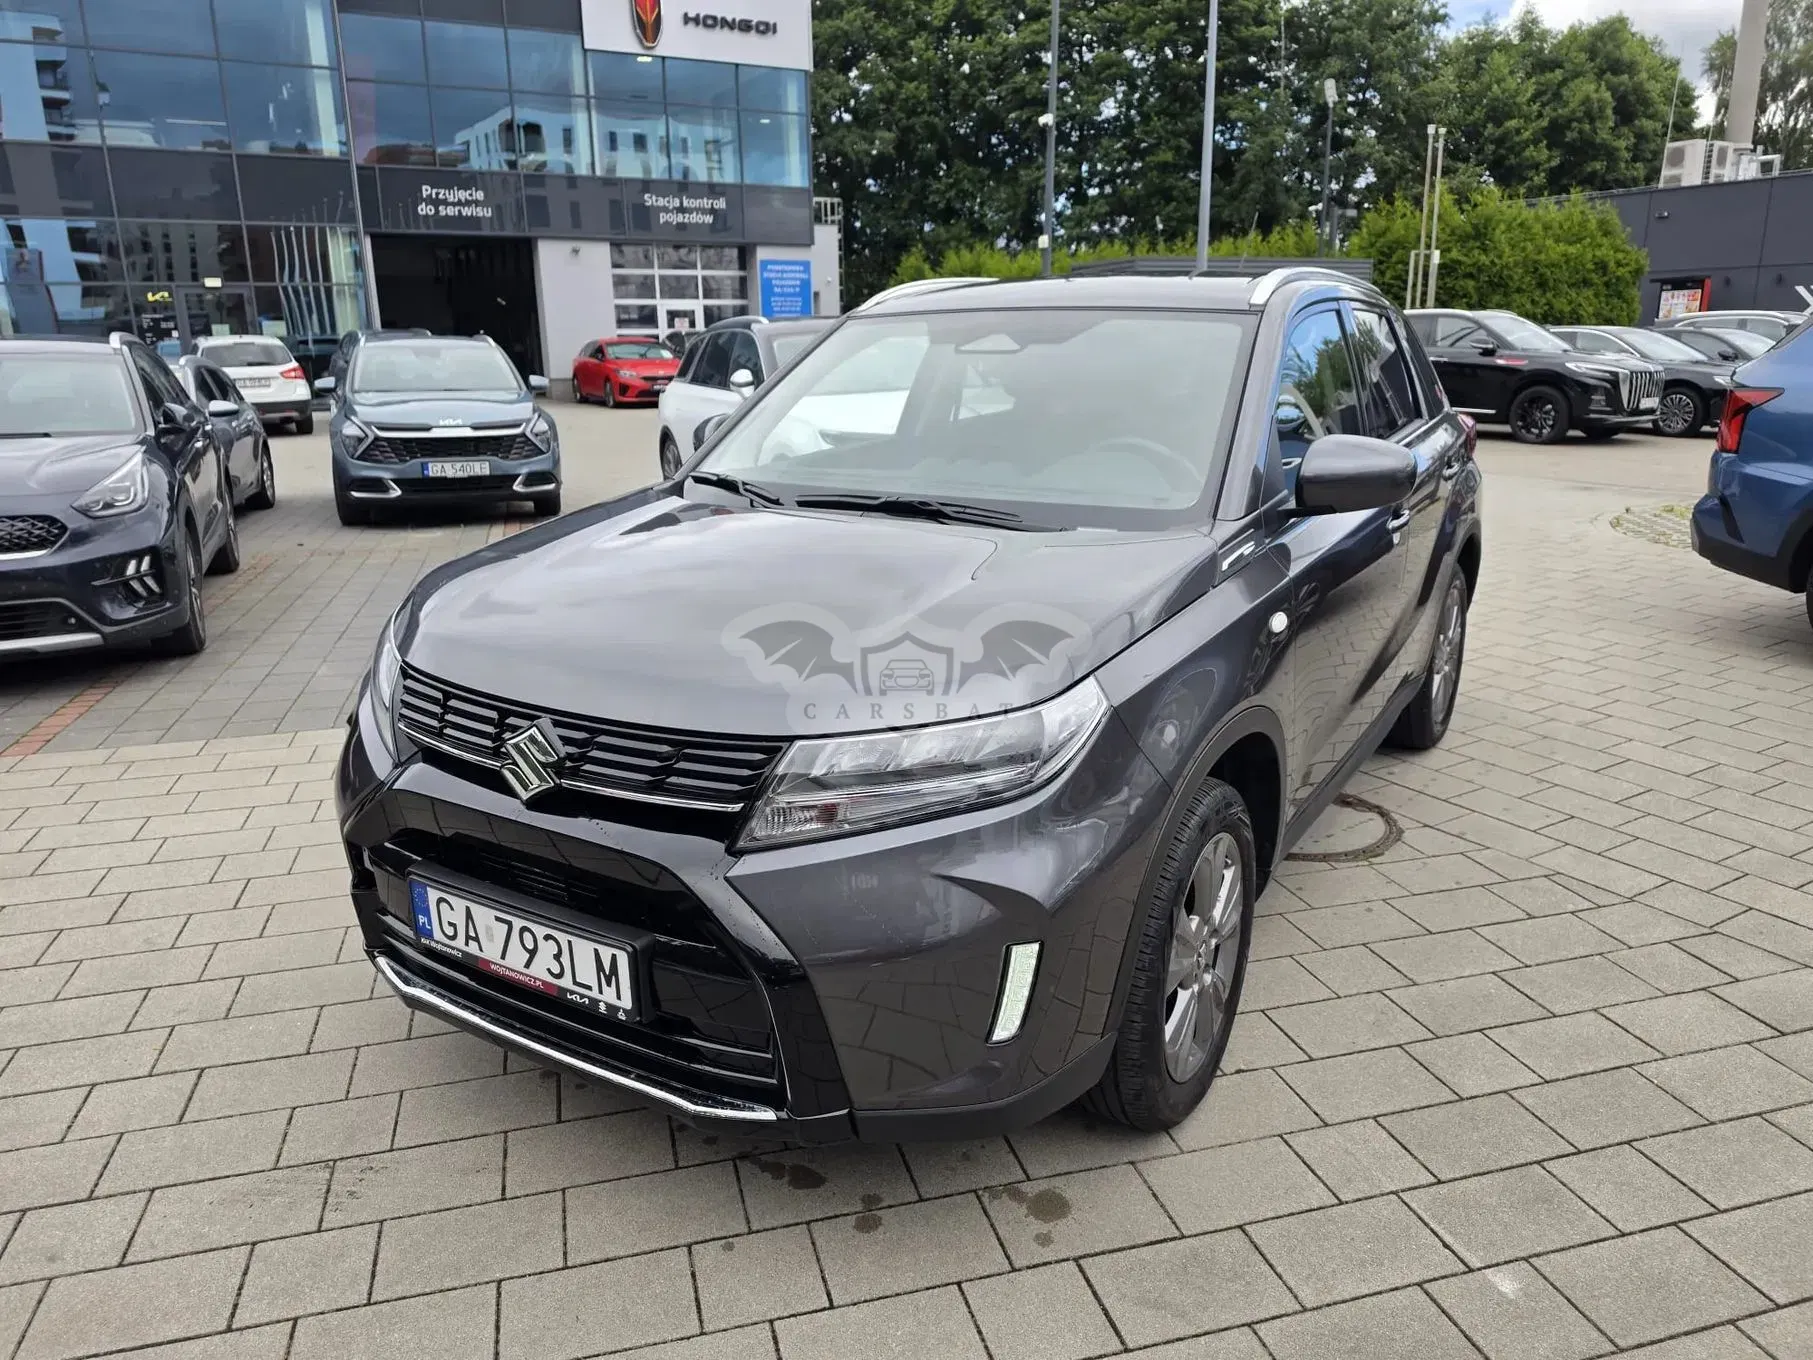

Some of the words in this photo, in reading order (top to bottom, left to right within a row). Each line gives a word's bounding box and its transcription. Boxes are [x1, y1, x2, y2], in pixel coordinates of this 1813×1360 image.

[683, 12, 778, 35] HONGQI
[421, 185, 485, 202] Przyjęcie
[643, 193, 681, 209] Stacja
[683, 195, 727, 210] kontroli
[417, 202, 435, 216] do
[438, 204, 492, 219] serwisu
[659, 211, 714, 225] pojazdów
[431, 463, 447, 475] GA
[418, 914, 432, 930] PL
[435, 896, 485, 953] GA
[494, 915, 623, 1002] 793LM
